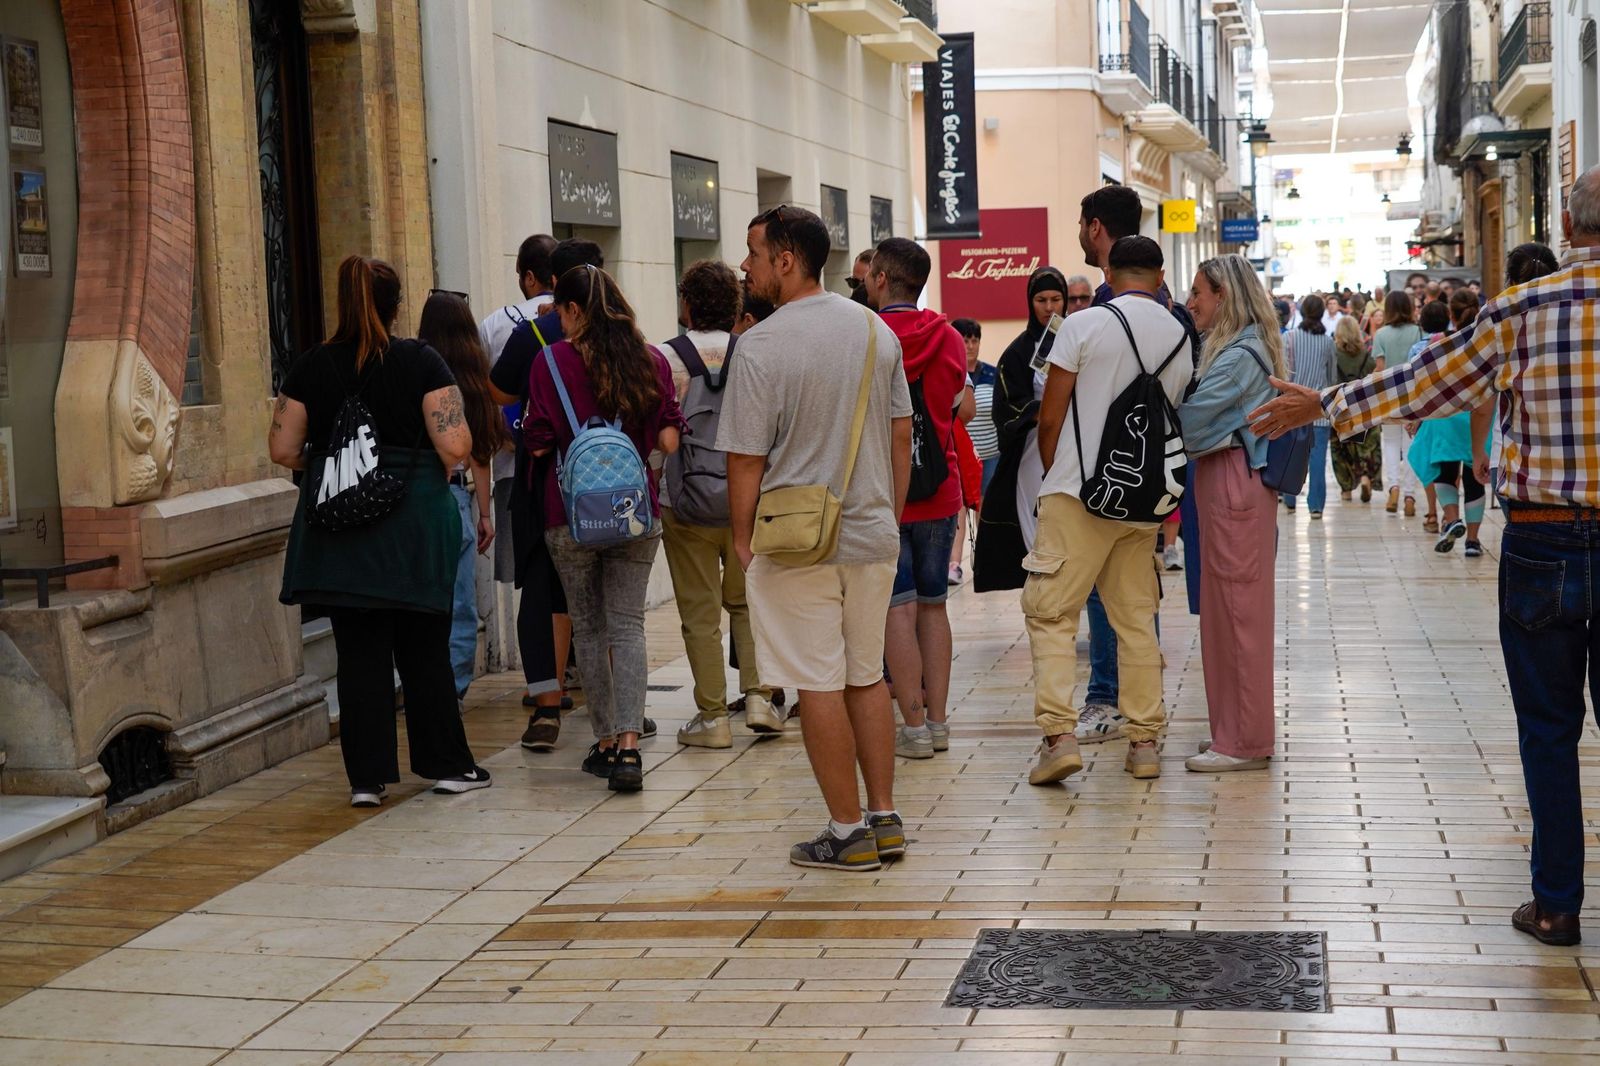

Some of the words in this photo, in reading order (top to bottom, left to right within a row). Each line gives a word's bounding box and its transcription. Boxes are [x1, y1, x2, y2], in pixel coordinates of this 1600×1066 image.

[940, 49, 954, 110] VIAJES
[943, 131, 961, 170] Corte
[946, 258, 975, 280] La
[974, 256, 1041, 281] Tagliatell
[316, 423, 379, 506] NIKE
[579, 518, 619, 530] Stitch
